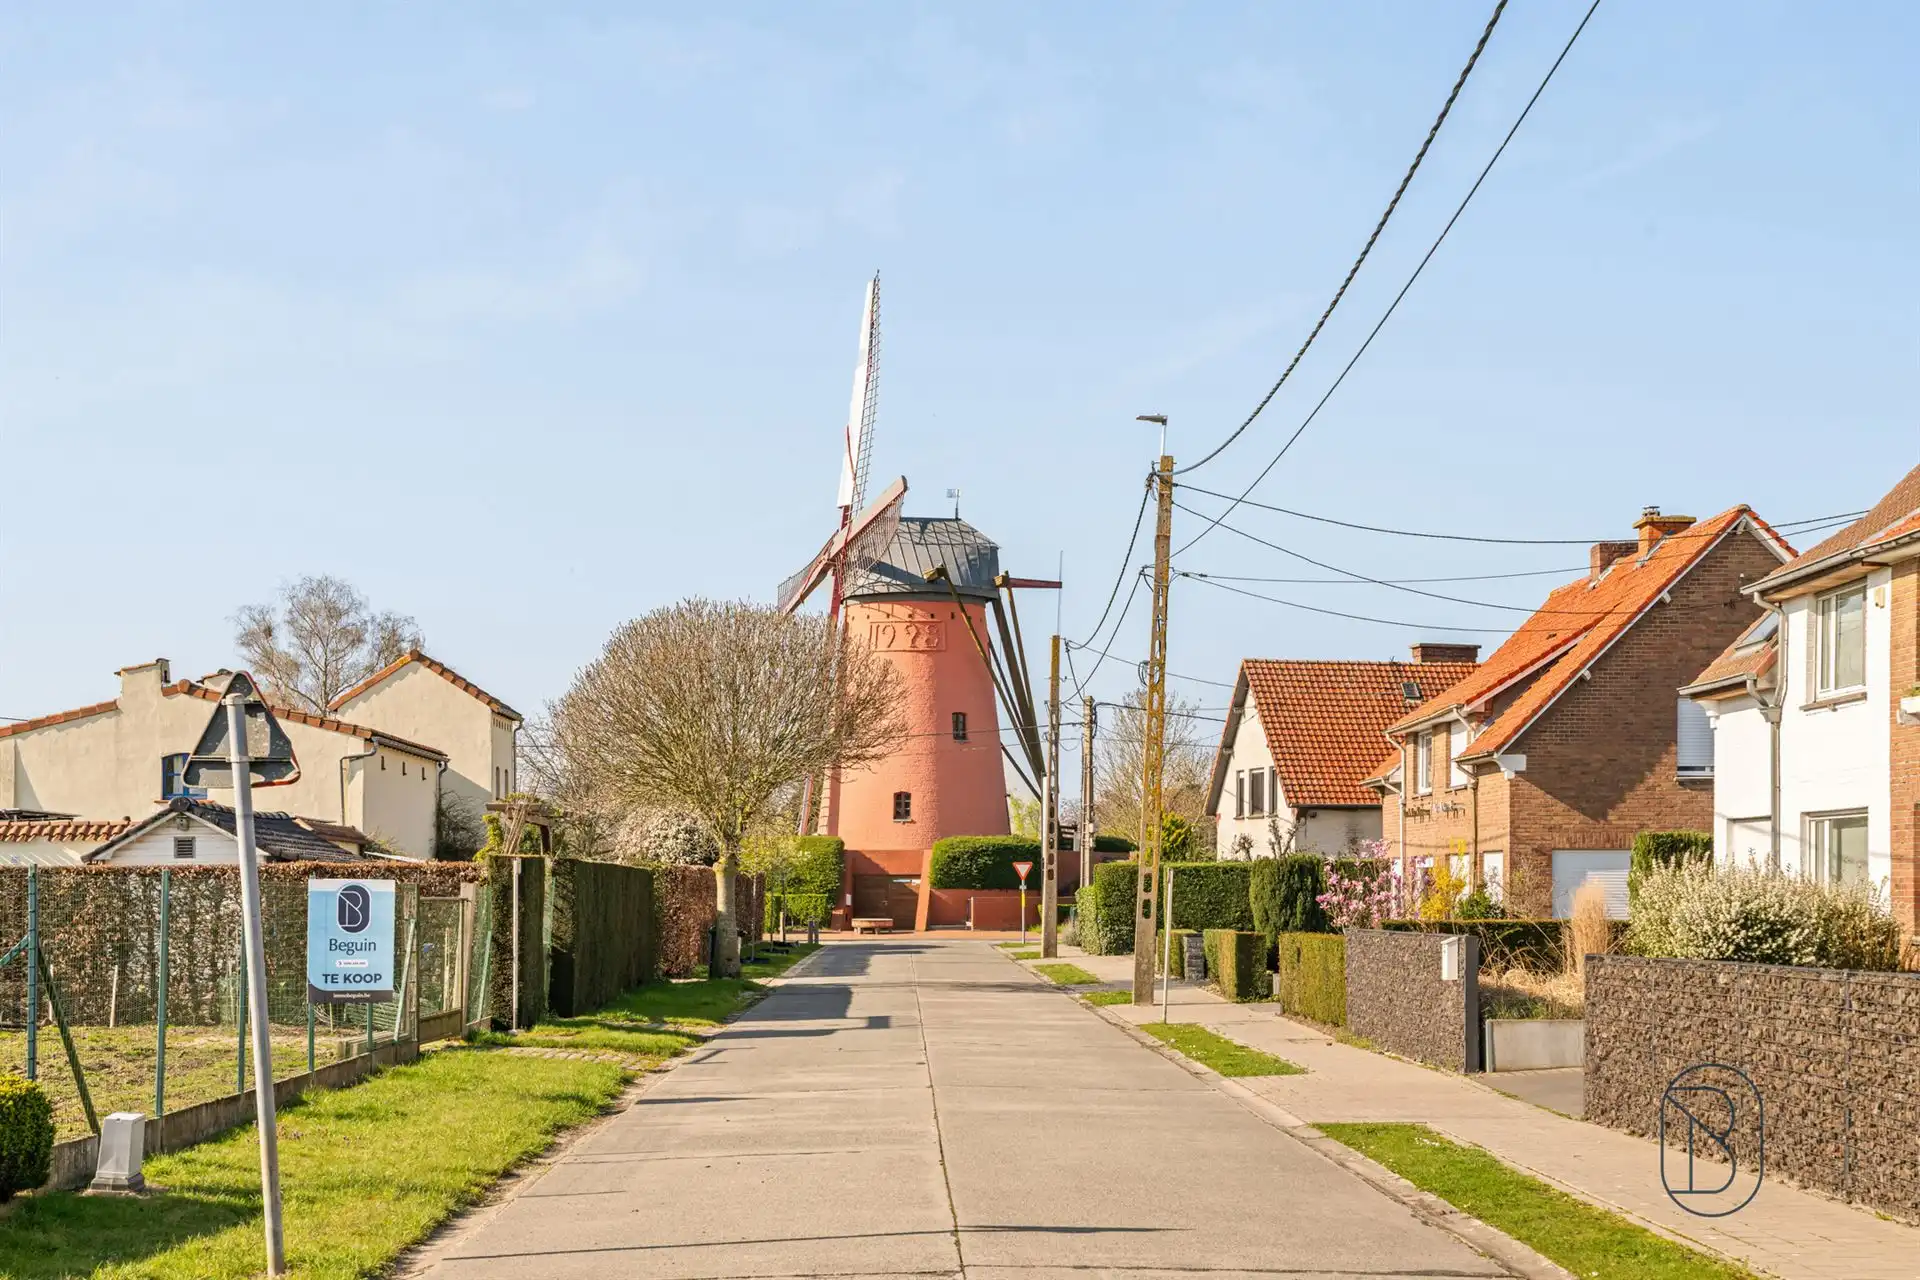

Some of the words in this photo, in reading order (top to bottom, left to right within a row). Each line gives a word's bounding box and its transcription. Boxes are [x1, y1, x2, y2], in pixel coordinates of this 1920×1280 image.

[329, 938, 377, 956] Beguin
[322, 973, 340, 984] TE
[343, 973, 382, 984] KOOP
